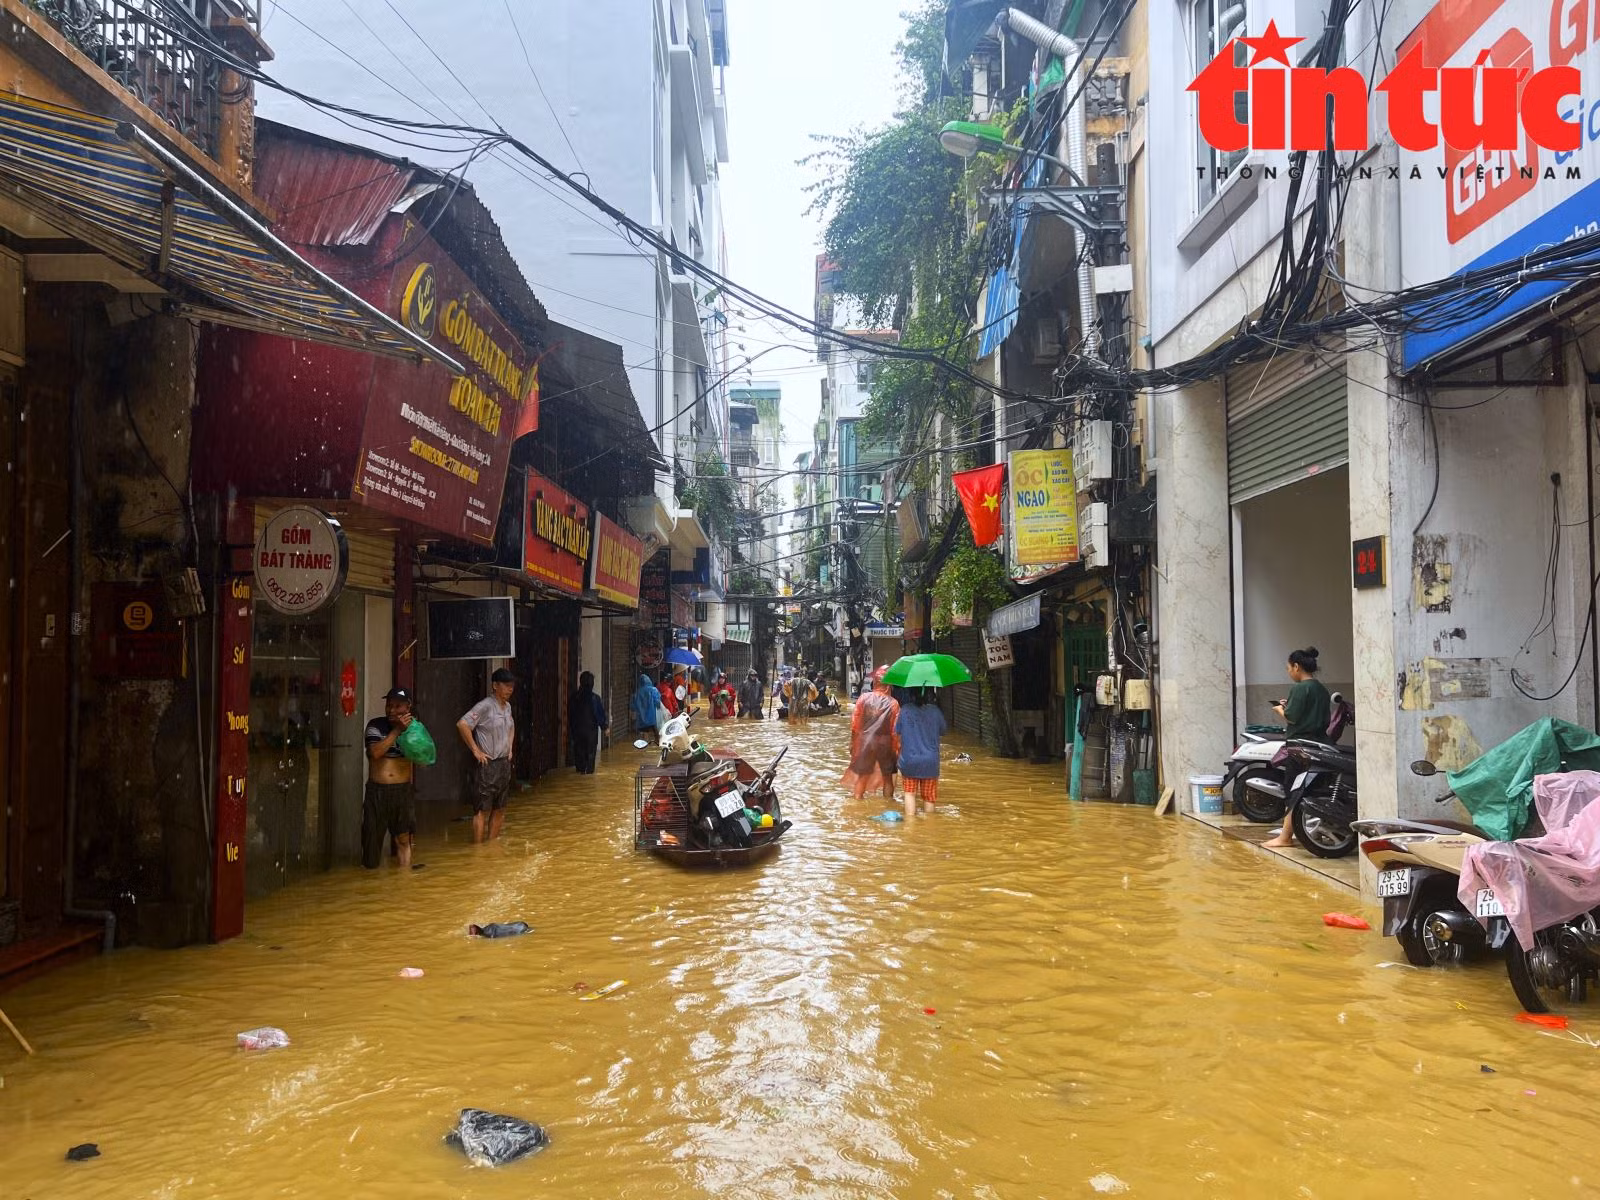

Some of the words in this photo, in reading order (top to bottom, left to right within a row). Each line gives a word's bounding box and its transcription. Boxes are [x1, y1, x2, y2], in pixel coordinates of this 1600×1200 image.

[1016, 462, 1042, 486] ỐC
[1017, 489, 1045, 508] NGAO
[281, 523, 311, 544] GỐM
[260, 548, 286, 568] BÁT
[289, 549, 332, 570] TRÀNG
[989, 654, 1010, 663] NAM
[1382, 869, 1406, 883] 29-S2
[1379, 882, 1408, 896] 015.99
